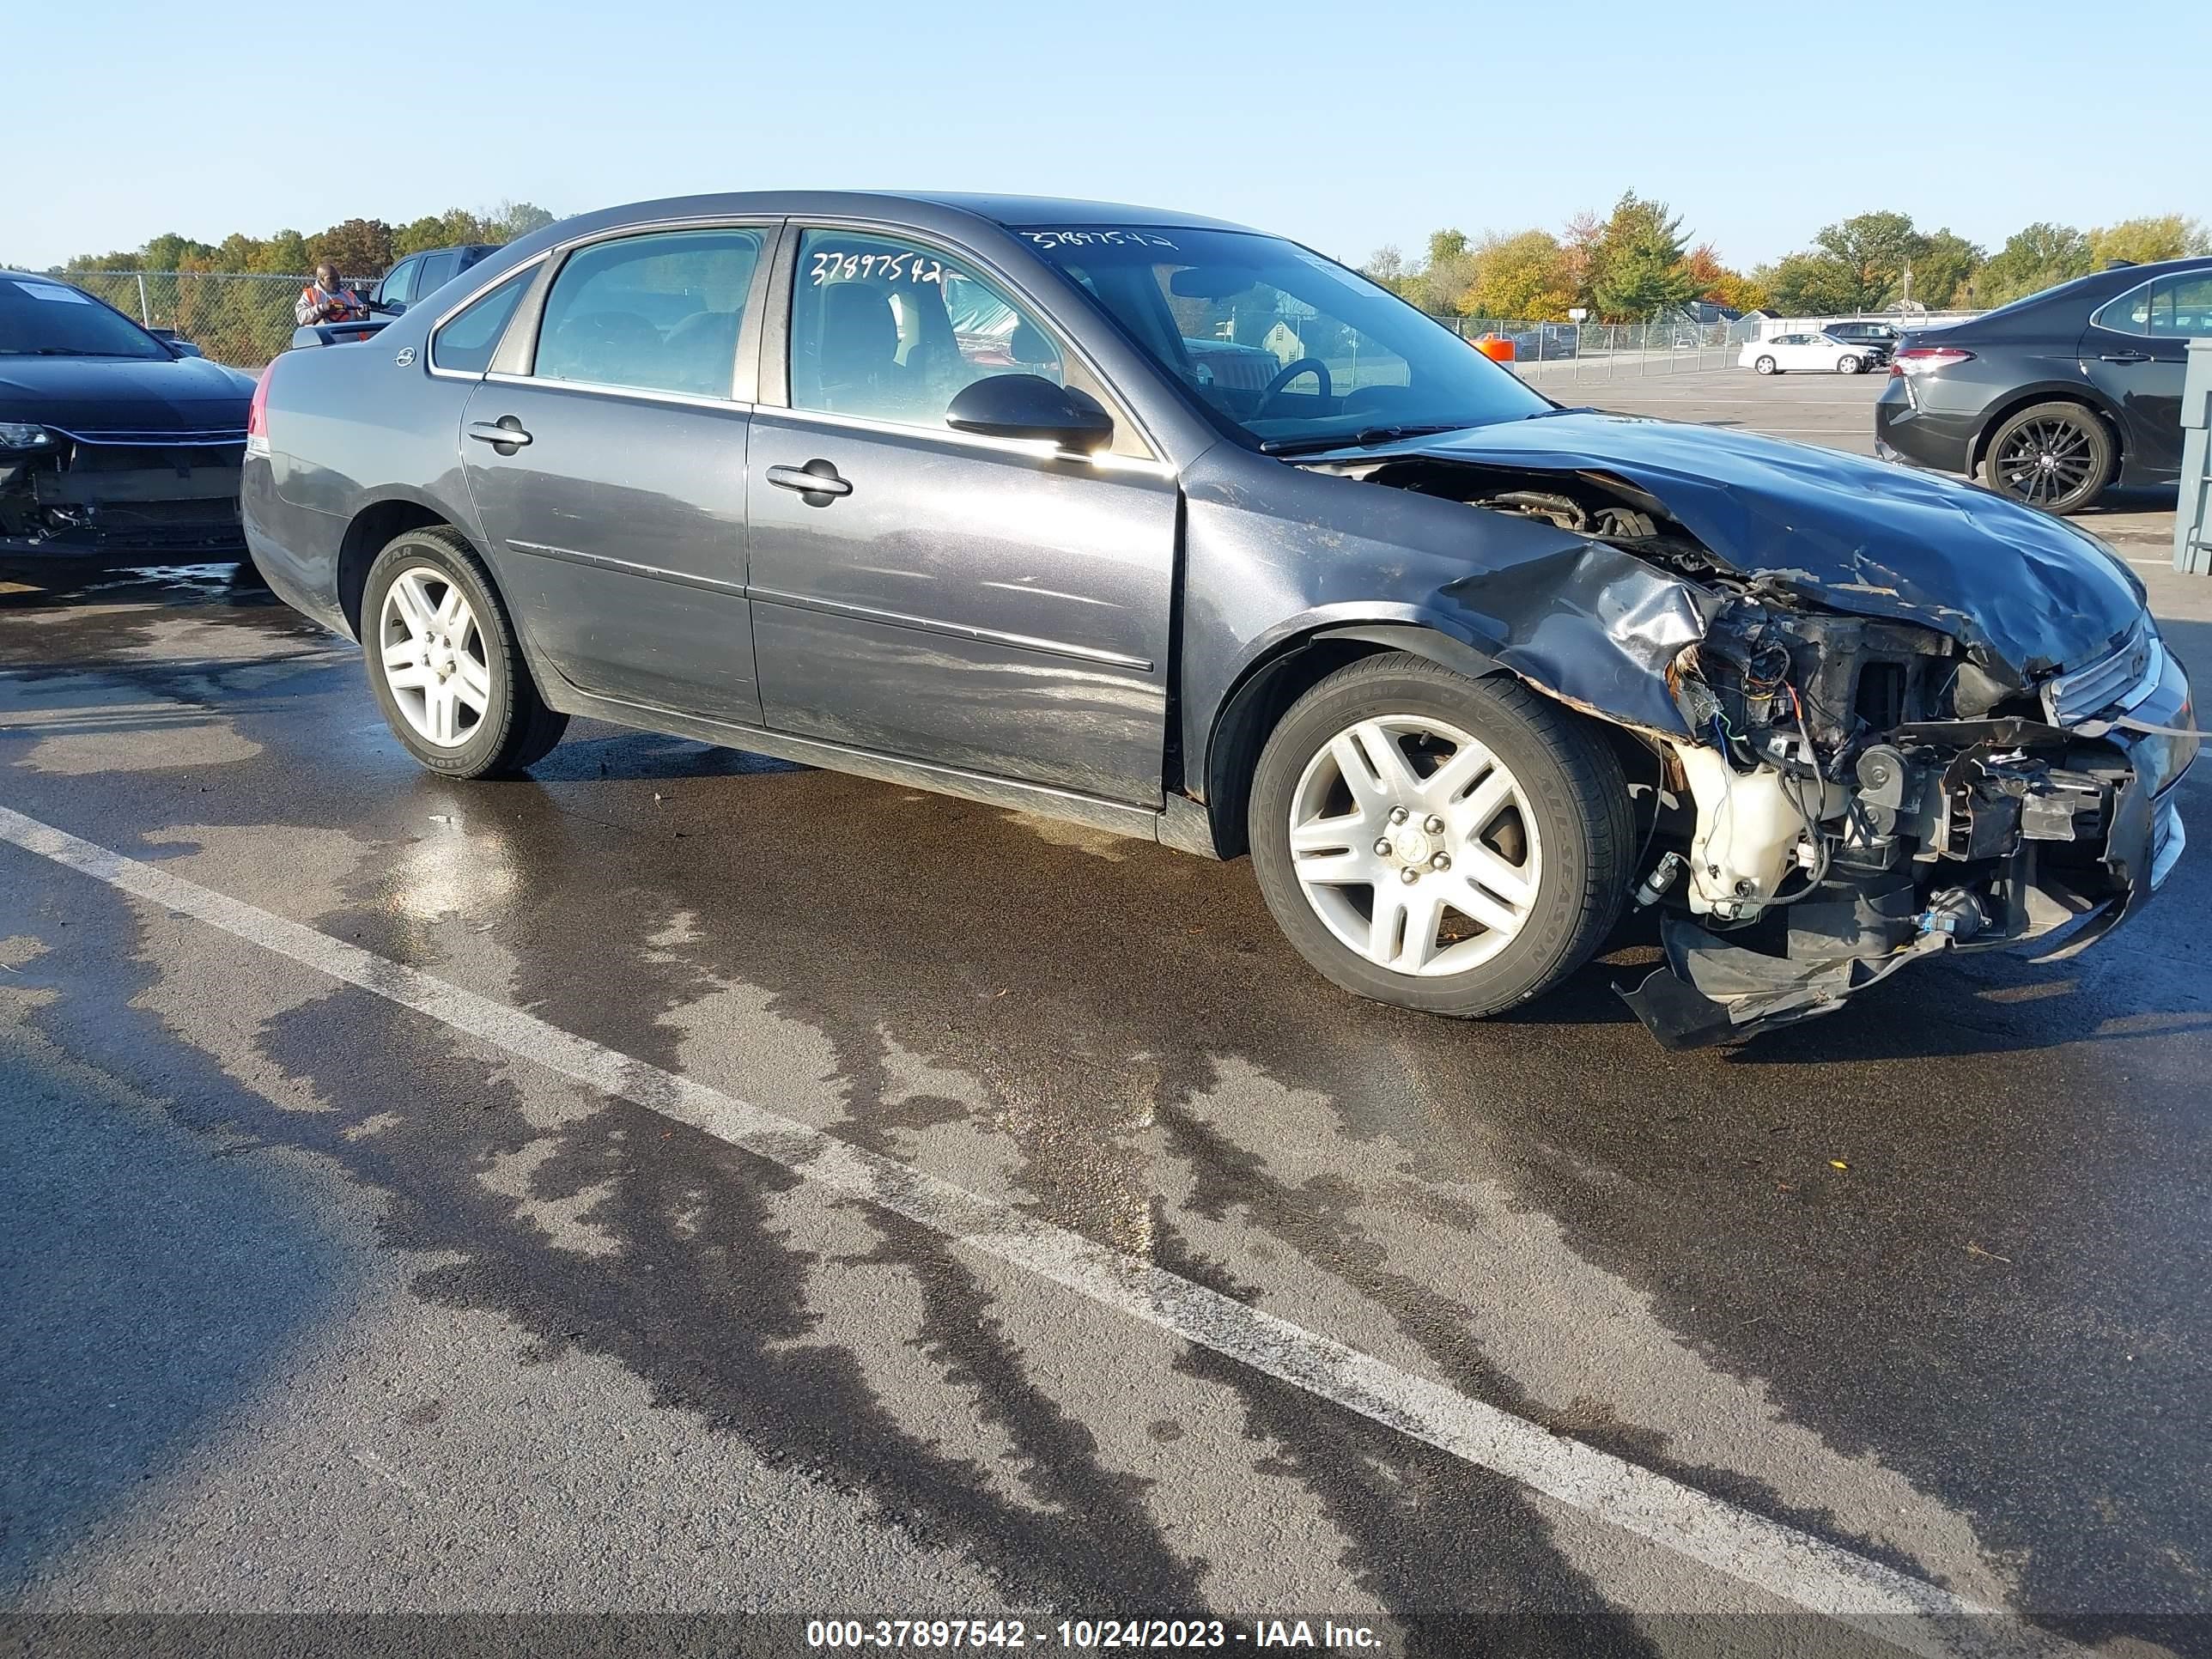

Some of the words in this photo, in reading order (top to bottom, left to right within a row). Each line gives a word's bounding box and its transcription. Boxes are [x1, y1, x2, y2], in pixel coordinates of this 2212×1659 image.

[1019, 231, 1179, 251] 37897542
[810, 252, 941, 286] 37897542
[1532, 775, 1573, 963] ALL-SEASON
